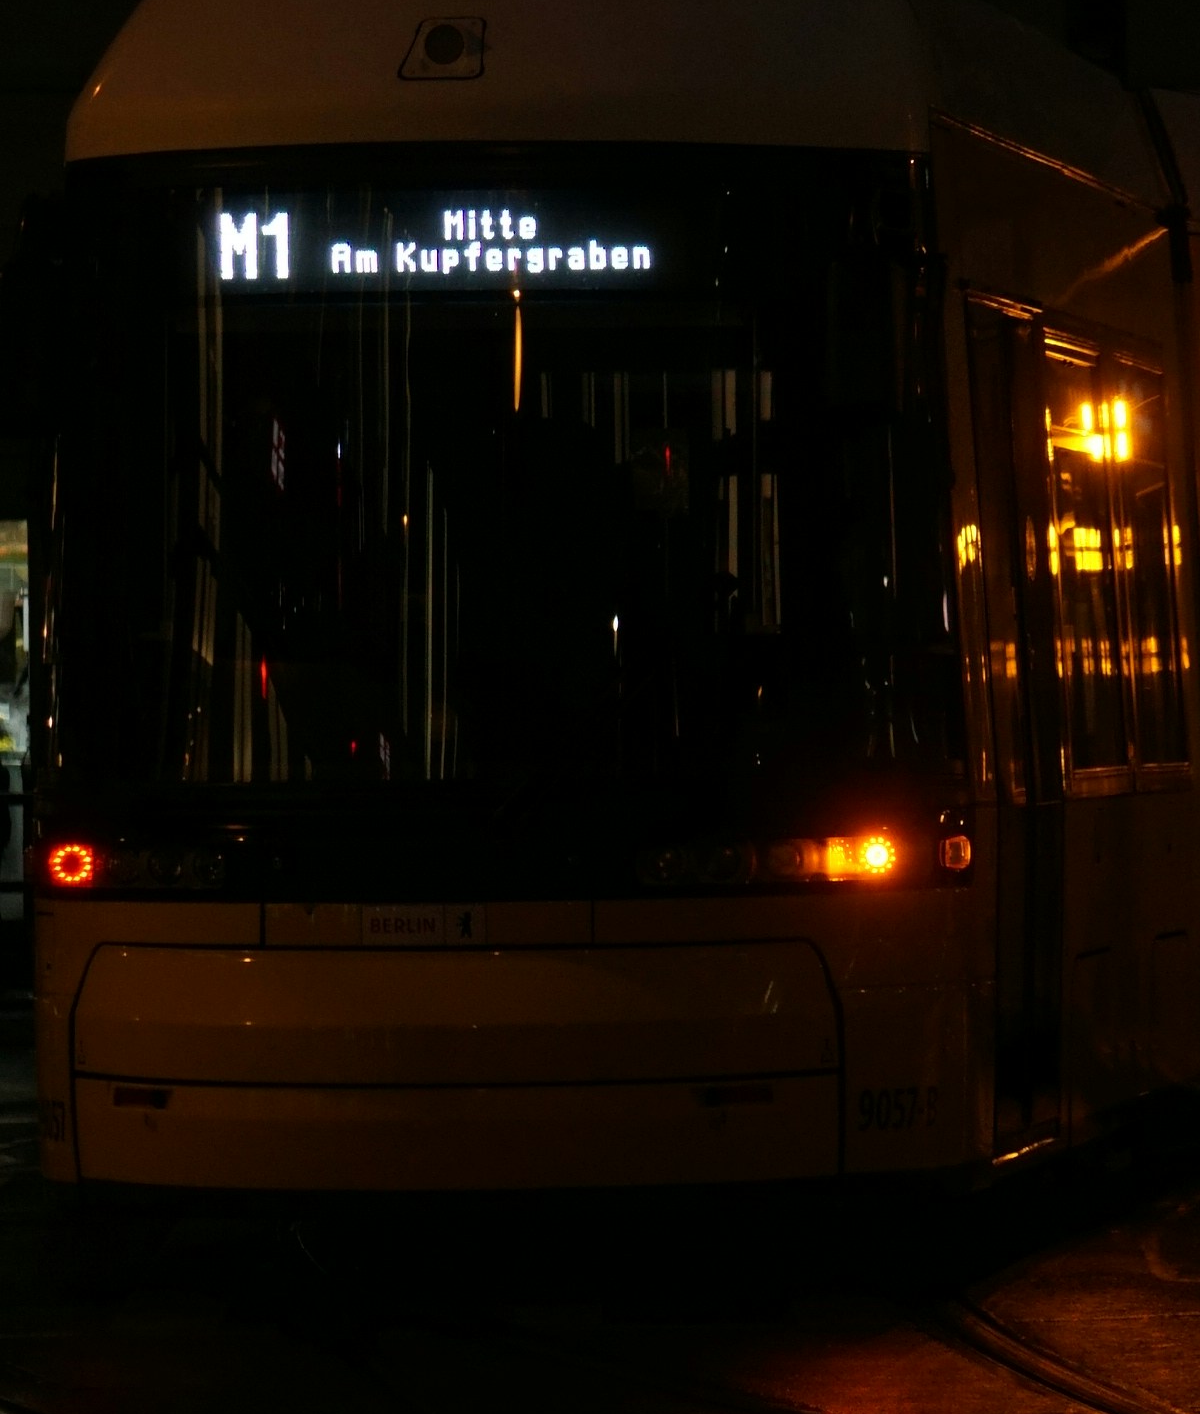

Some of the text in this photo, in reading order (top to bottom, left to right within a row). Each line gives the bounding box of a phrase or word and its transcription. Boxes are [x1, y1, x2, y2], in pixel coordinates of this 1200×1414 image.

[443, 209, 537, 241] Mitte
[219, 211, 290, 280] M1
[331, 240, 652, 274] Am Kupfergraben
[371, 918, 435, 934] BERLIN
